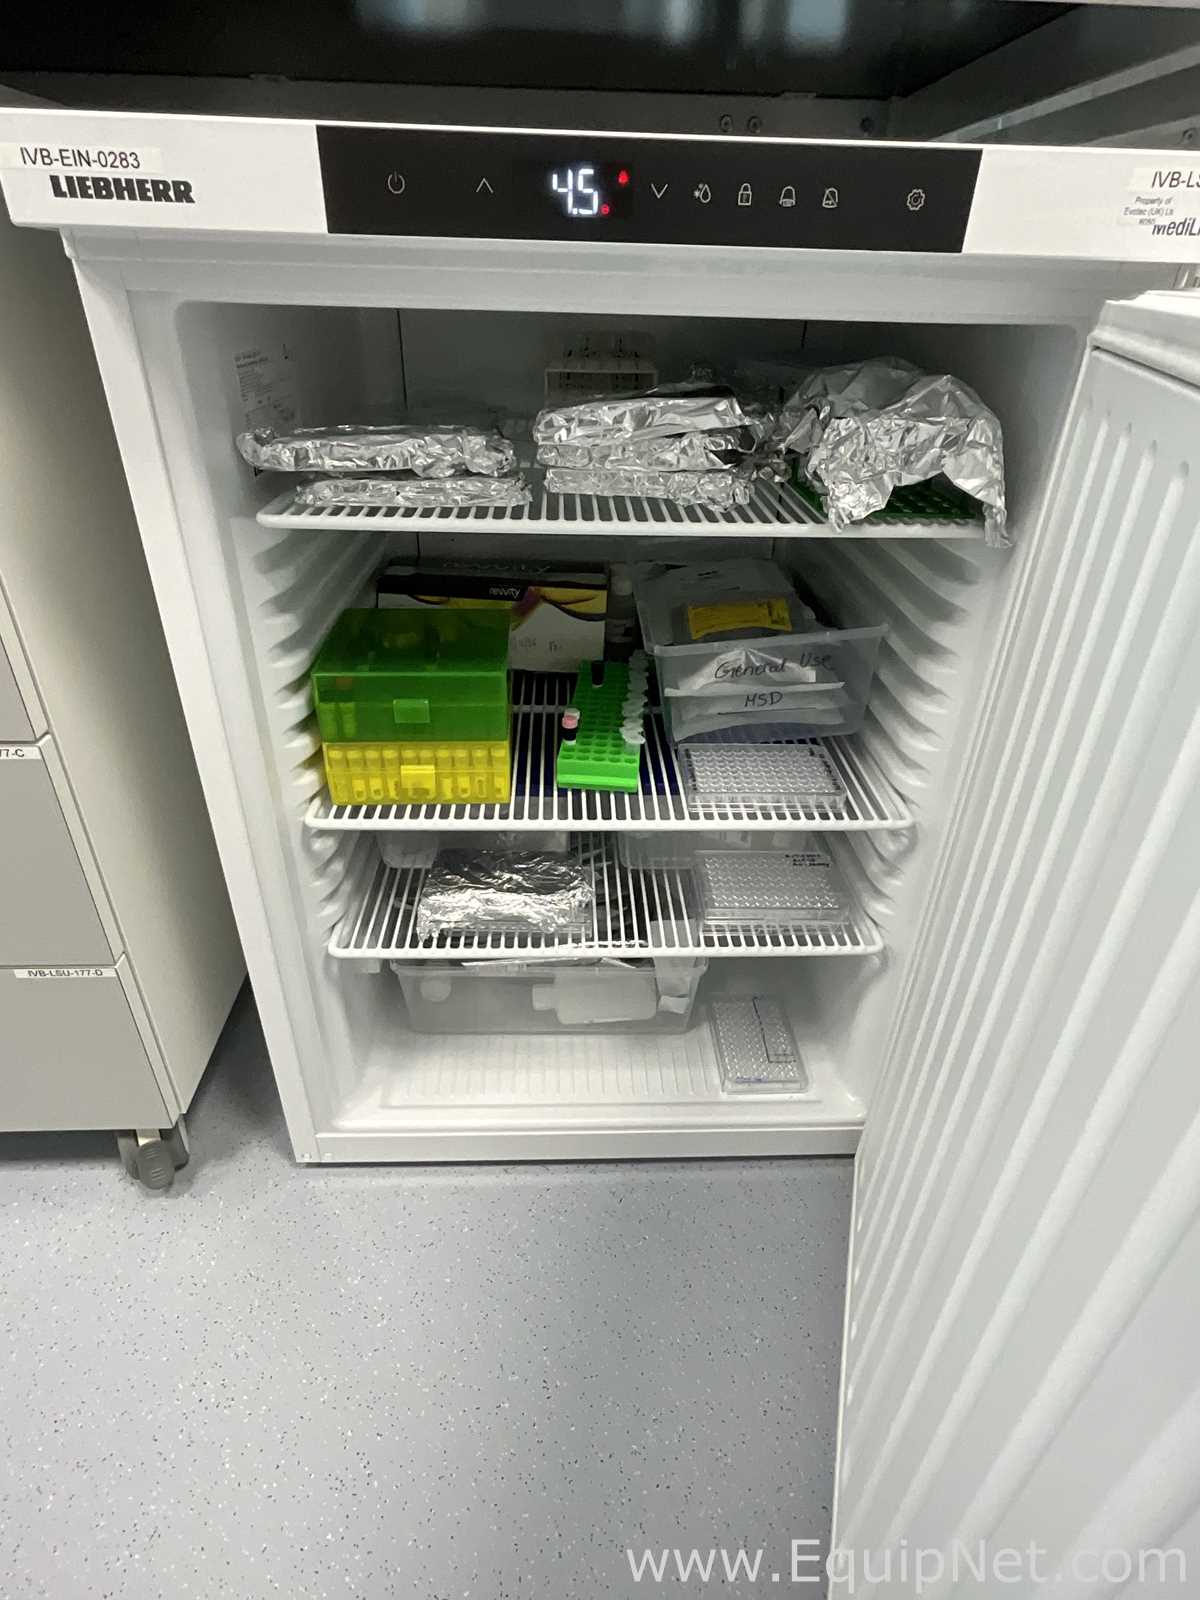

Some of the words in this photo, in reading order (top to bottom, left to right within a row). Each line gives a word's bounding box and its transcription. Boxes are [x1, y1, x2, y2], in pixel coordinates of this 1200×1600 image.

[20, 146, 141, 169] IVB-EIN-0283
[50, 174, 196, 204] LIEBHERR
[1151, 217, 1200, 237] MediL
[714, 656, 787, 680] General
